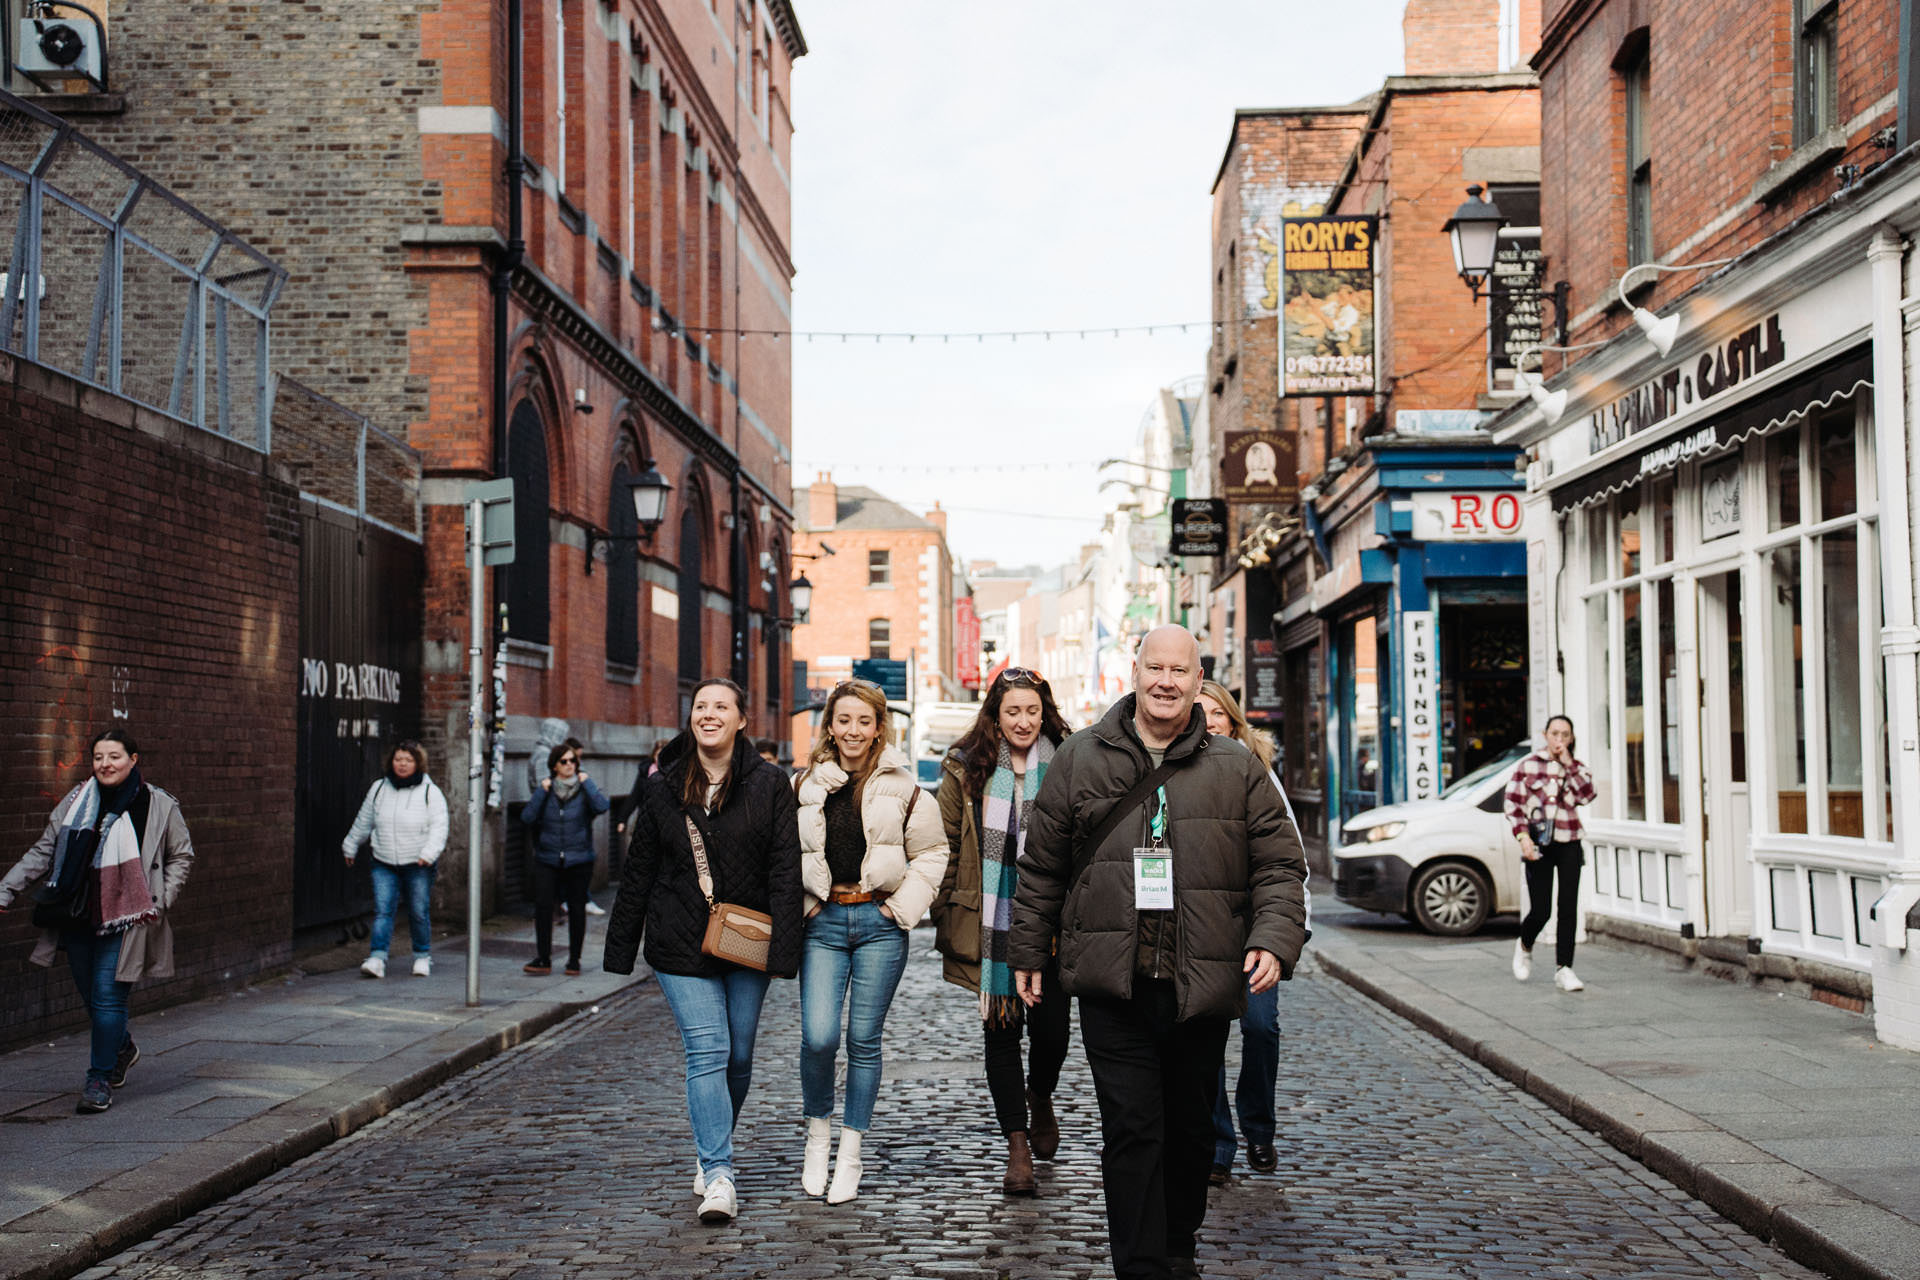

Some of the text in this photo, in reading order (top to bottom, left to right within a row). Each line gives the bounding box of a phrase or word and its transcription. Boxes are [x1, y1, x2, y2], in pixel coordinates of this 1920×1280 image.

[1285, 220, 1370, 251] RORY'S
[1697, 312, 1786, 402] CASTLE
[1184, 501, 1213, 511] PIZZA
[1174, 522, 1223, 534] BURGERS
[1178, 543, 1218, 552] KEBABS
[302, 658, 400, 704] NO PARKING
[1413, 620, 1429, 726] FISHING
